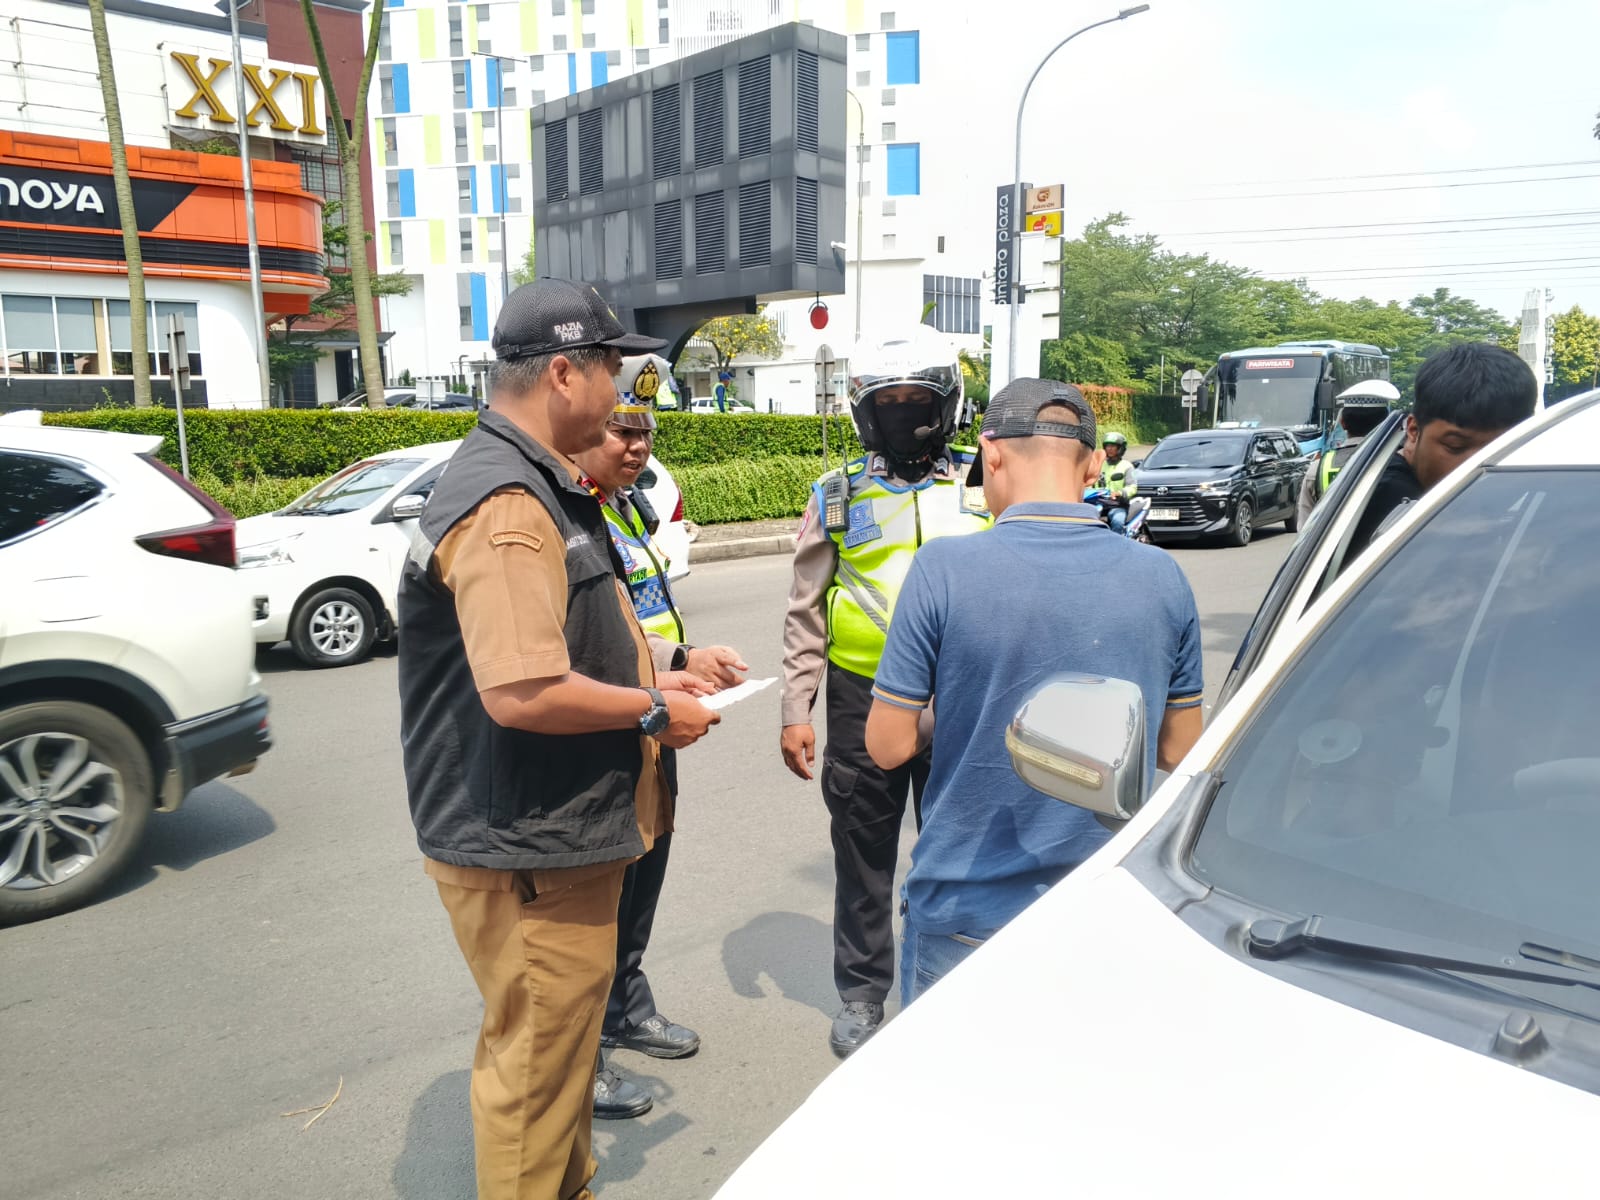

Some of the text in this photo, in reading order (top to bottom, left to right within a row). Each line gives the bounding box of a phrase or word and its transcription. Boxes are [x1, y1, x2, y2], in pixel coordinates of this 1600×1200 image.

[171, 51, 325, 136] XXI
[997, 194, 1010, 242] plaza
[554, 321, 583, 335] RAZIA
[561, 330, 581, 342] PKB
[1249, 360, 1290, 368] PARIWISATA
